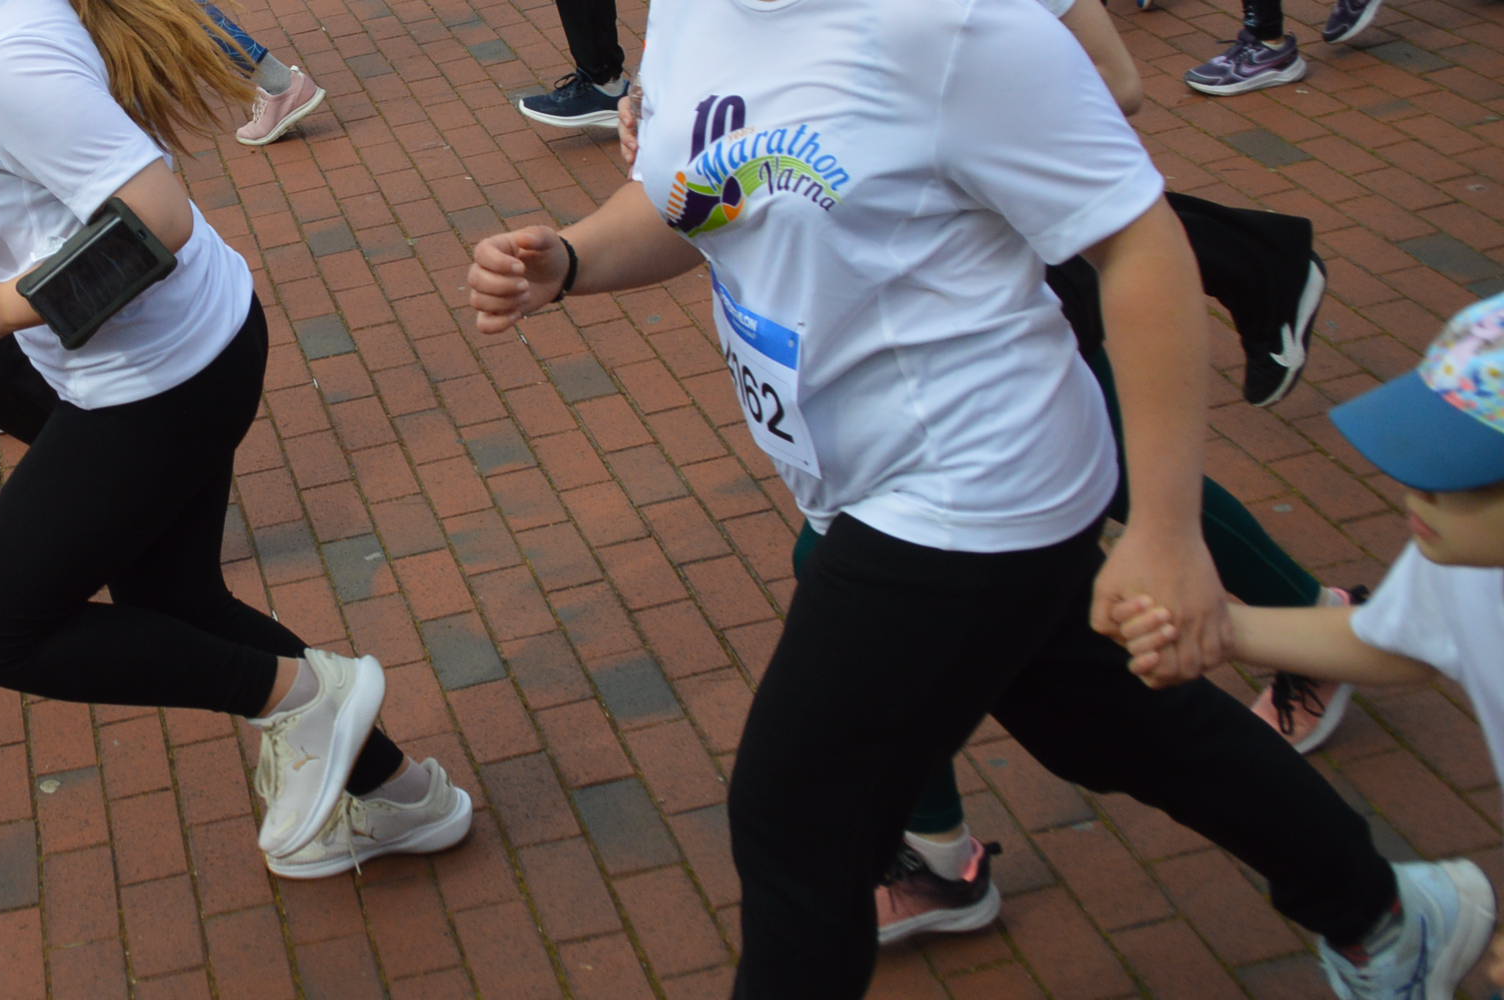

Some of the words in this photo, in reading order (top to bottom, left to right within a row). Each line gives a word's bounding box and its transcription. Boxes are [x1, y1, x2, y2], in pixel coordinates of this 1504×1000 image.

[687, 94, 746, 165] 10
[696, 123, 851, 193] Marathon
[759, 156, 837, 212] Varna
